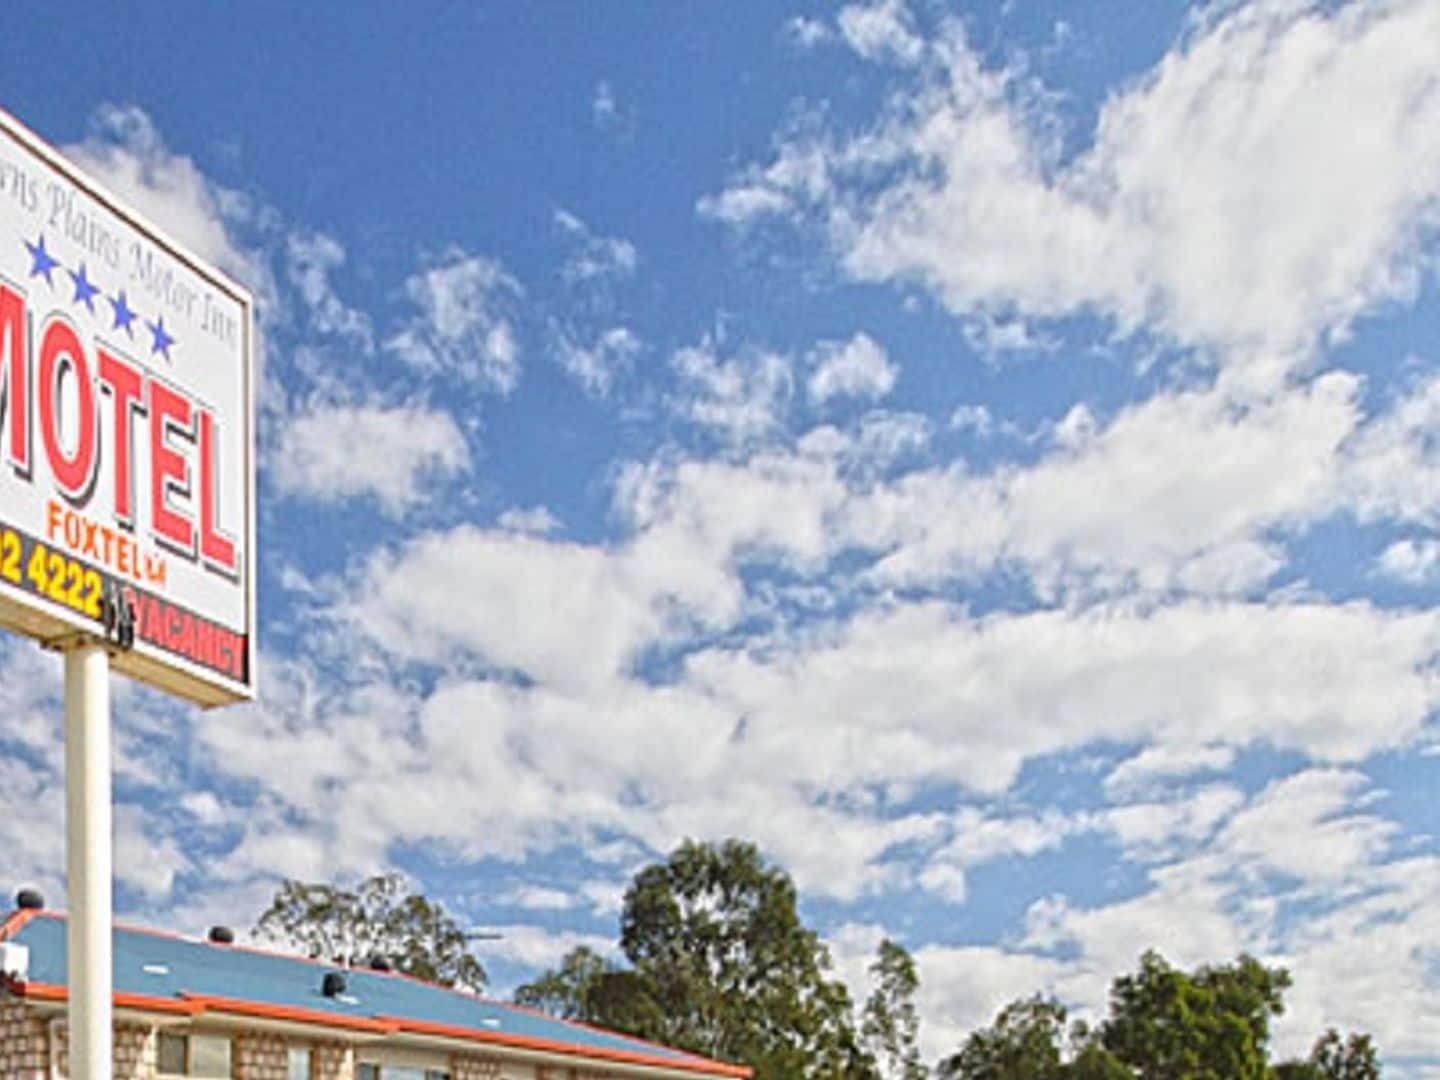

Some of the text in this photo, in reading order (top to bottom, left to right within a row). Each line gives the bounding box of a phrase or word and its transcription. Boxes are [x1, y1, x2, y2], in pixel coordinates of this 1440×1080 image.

[47, 183, 121, 268] Plains
[128, 241, 199, 319] Motor
[201, 292, 238, 350] Inn
[27, 545, 103, 620] 4222
[47, 500, 142, 580] FOXTEL
[125, 586, 245, 681] VACANCY
